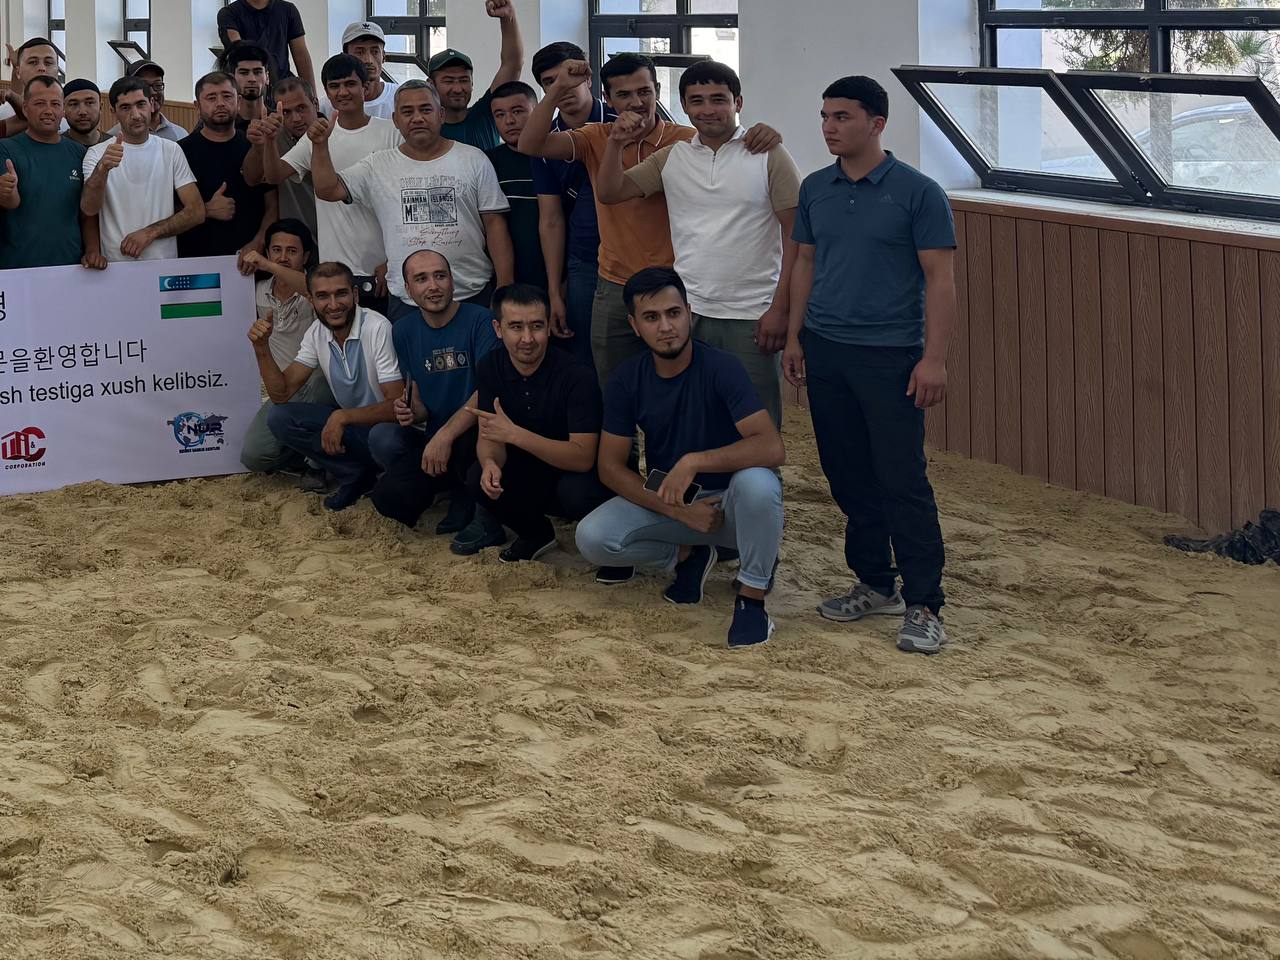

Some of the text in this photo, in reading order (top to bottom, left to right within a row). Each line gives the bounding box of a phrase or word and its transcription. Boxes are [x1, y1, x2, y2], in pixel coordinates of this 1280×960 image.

[29, 381, 94, 403] testiga
[100, 375, 146, 396] xush
[153, 369, 229, 392] kelibsiz.
